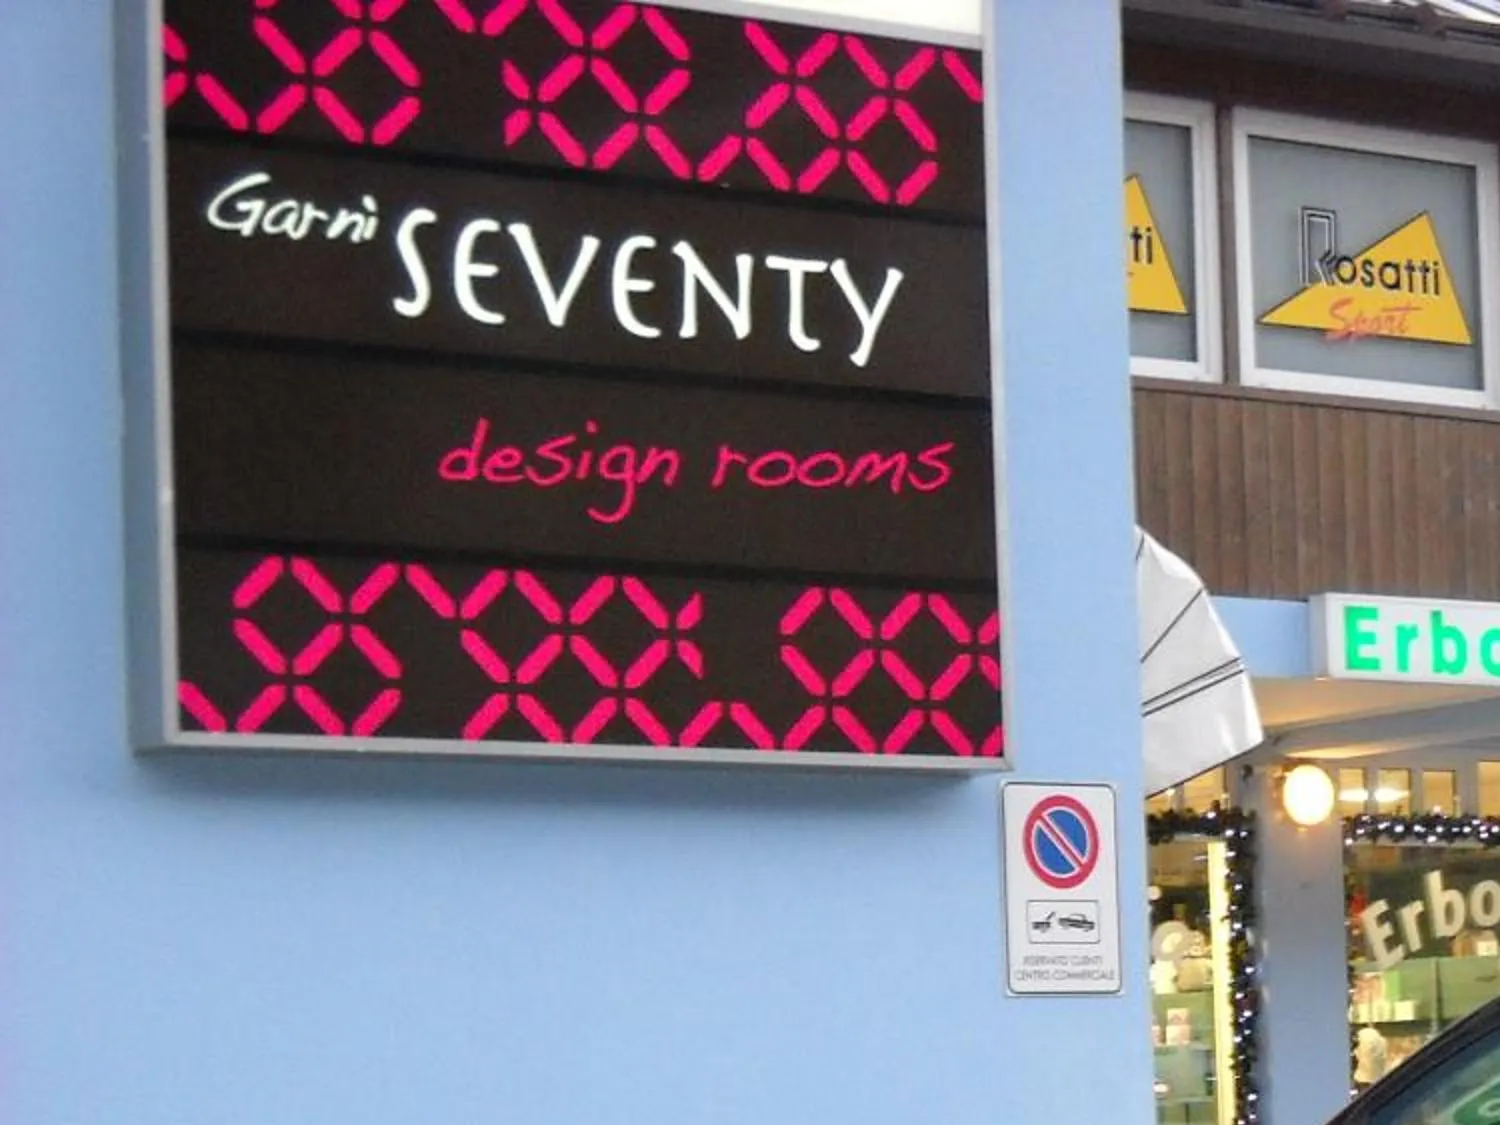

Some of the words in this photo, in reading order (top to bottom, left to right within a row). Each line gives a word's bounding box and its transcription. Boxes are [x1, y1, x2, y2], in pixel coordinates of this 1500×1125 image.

[392, 206, 905, 368] SEVENTY
[1300, 205, 1441, 296] Rosatti
[1325, 296, 1423, 342] Sport
[437, 417, 683, 525] design
[710, 440, 956, 494] rooms
